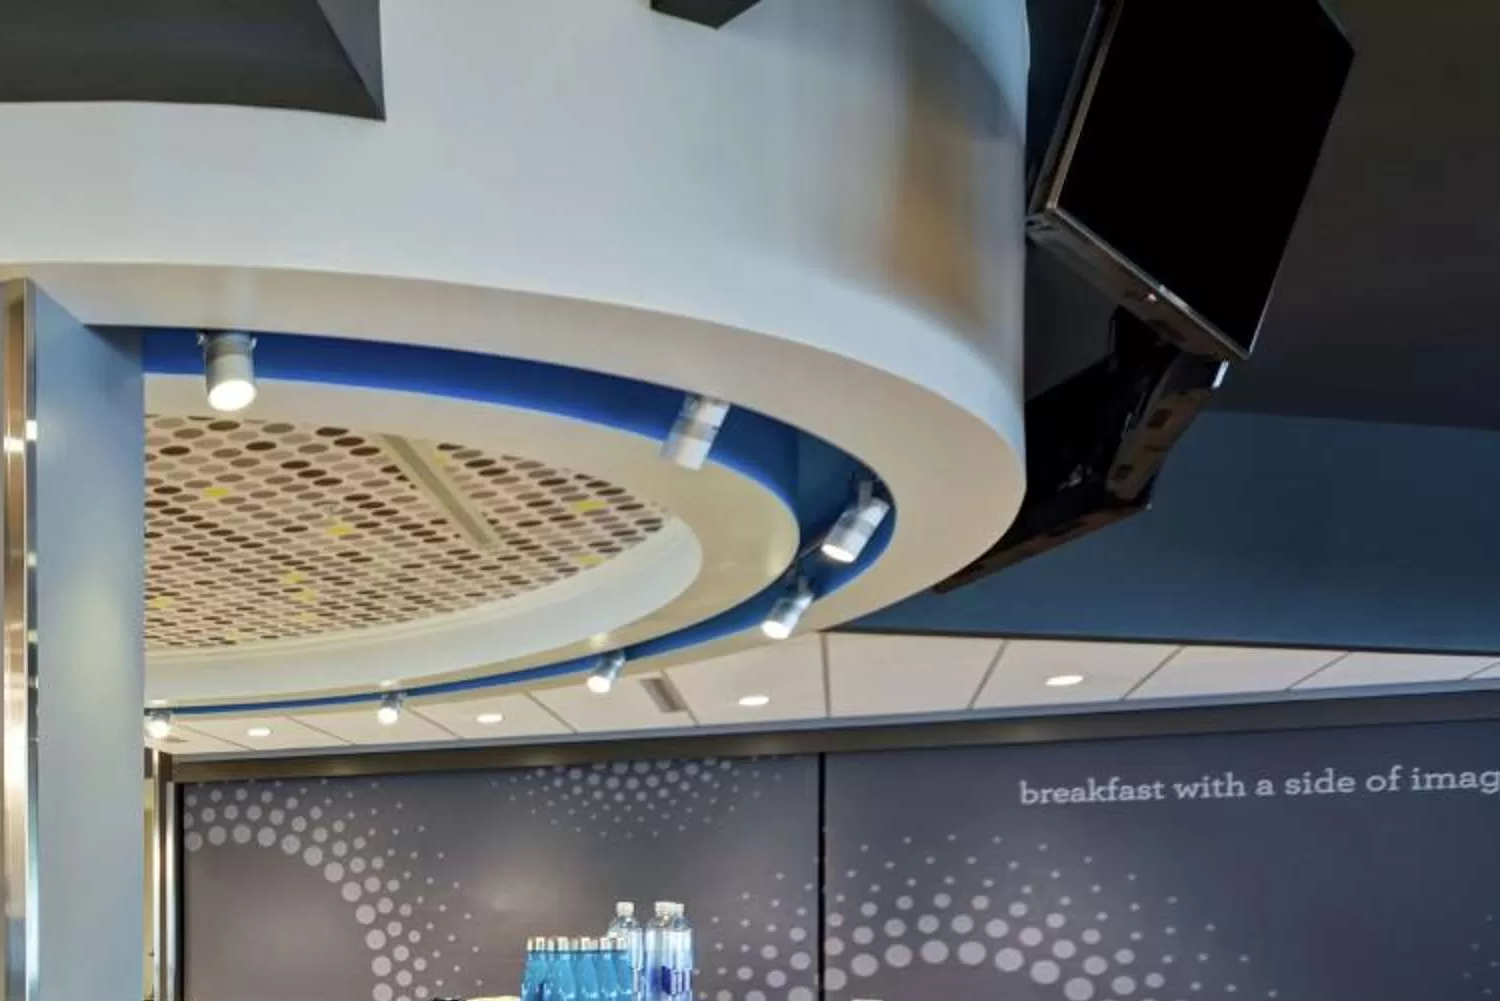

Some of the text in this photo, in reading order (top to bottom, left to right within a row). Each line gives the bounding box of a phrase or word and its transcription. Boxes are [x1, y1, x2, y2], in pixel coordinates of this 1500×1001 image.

[1019, 778, 1164, 805] breakfast
[1172, 772, 1246, 799] with
[1254, 780, 1274, 796] a
[1285, 768, 1356, 795] side
[1365, 764, 1403, 792] of
